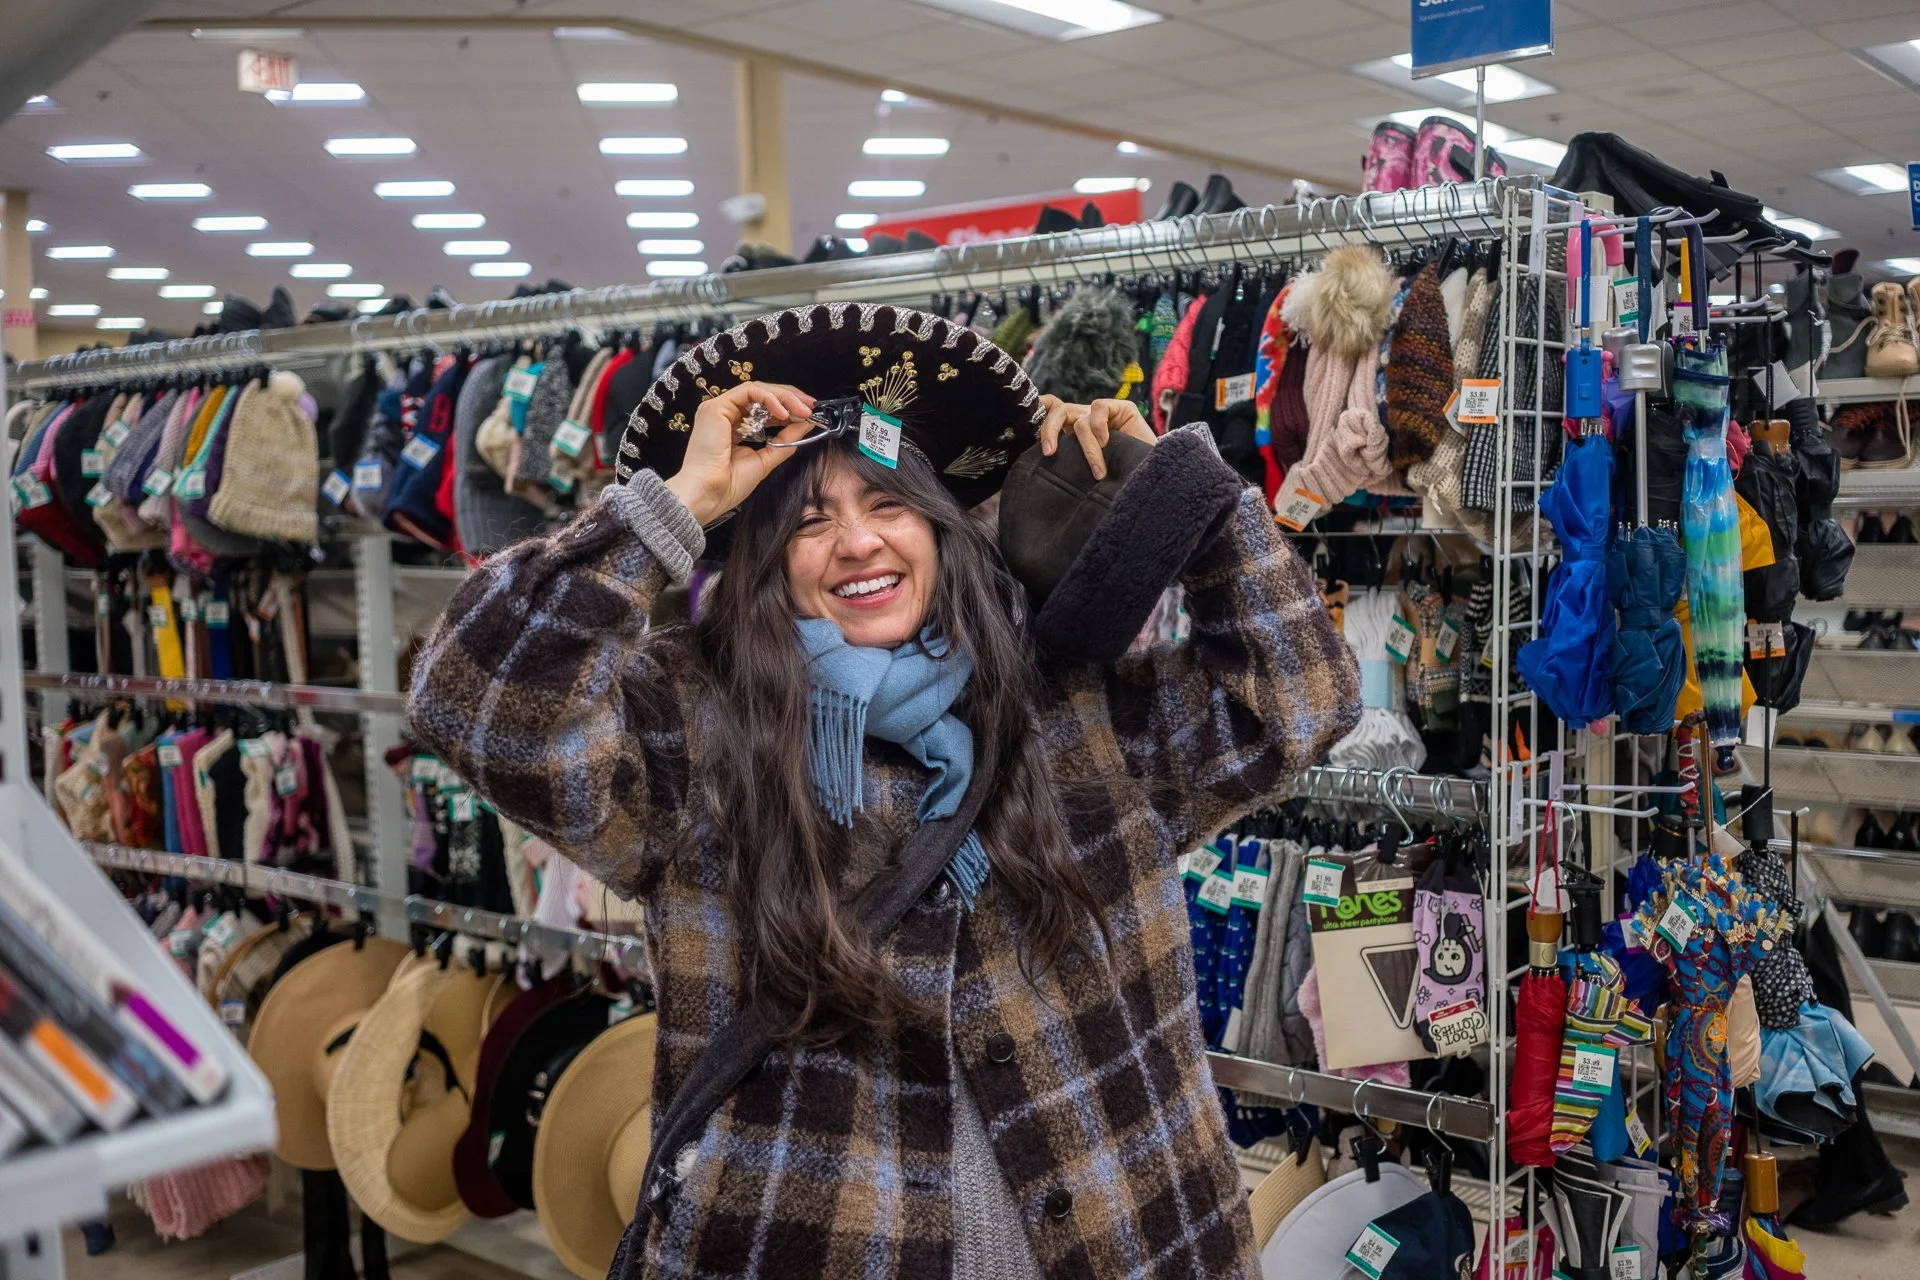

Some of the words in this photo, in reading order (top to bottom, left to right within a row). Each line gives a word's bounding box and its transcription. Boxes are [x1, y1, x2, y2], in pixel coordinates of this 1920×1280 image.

[870, 422, 888, 437] $7.99
[1321, 890, 1402, 920] anes
[1323, 919, 1339, 930] ultra
[1340, 918, 1360, 928] sheer
[1360, 916, 1398, 926] pantyhose
